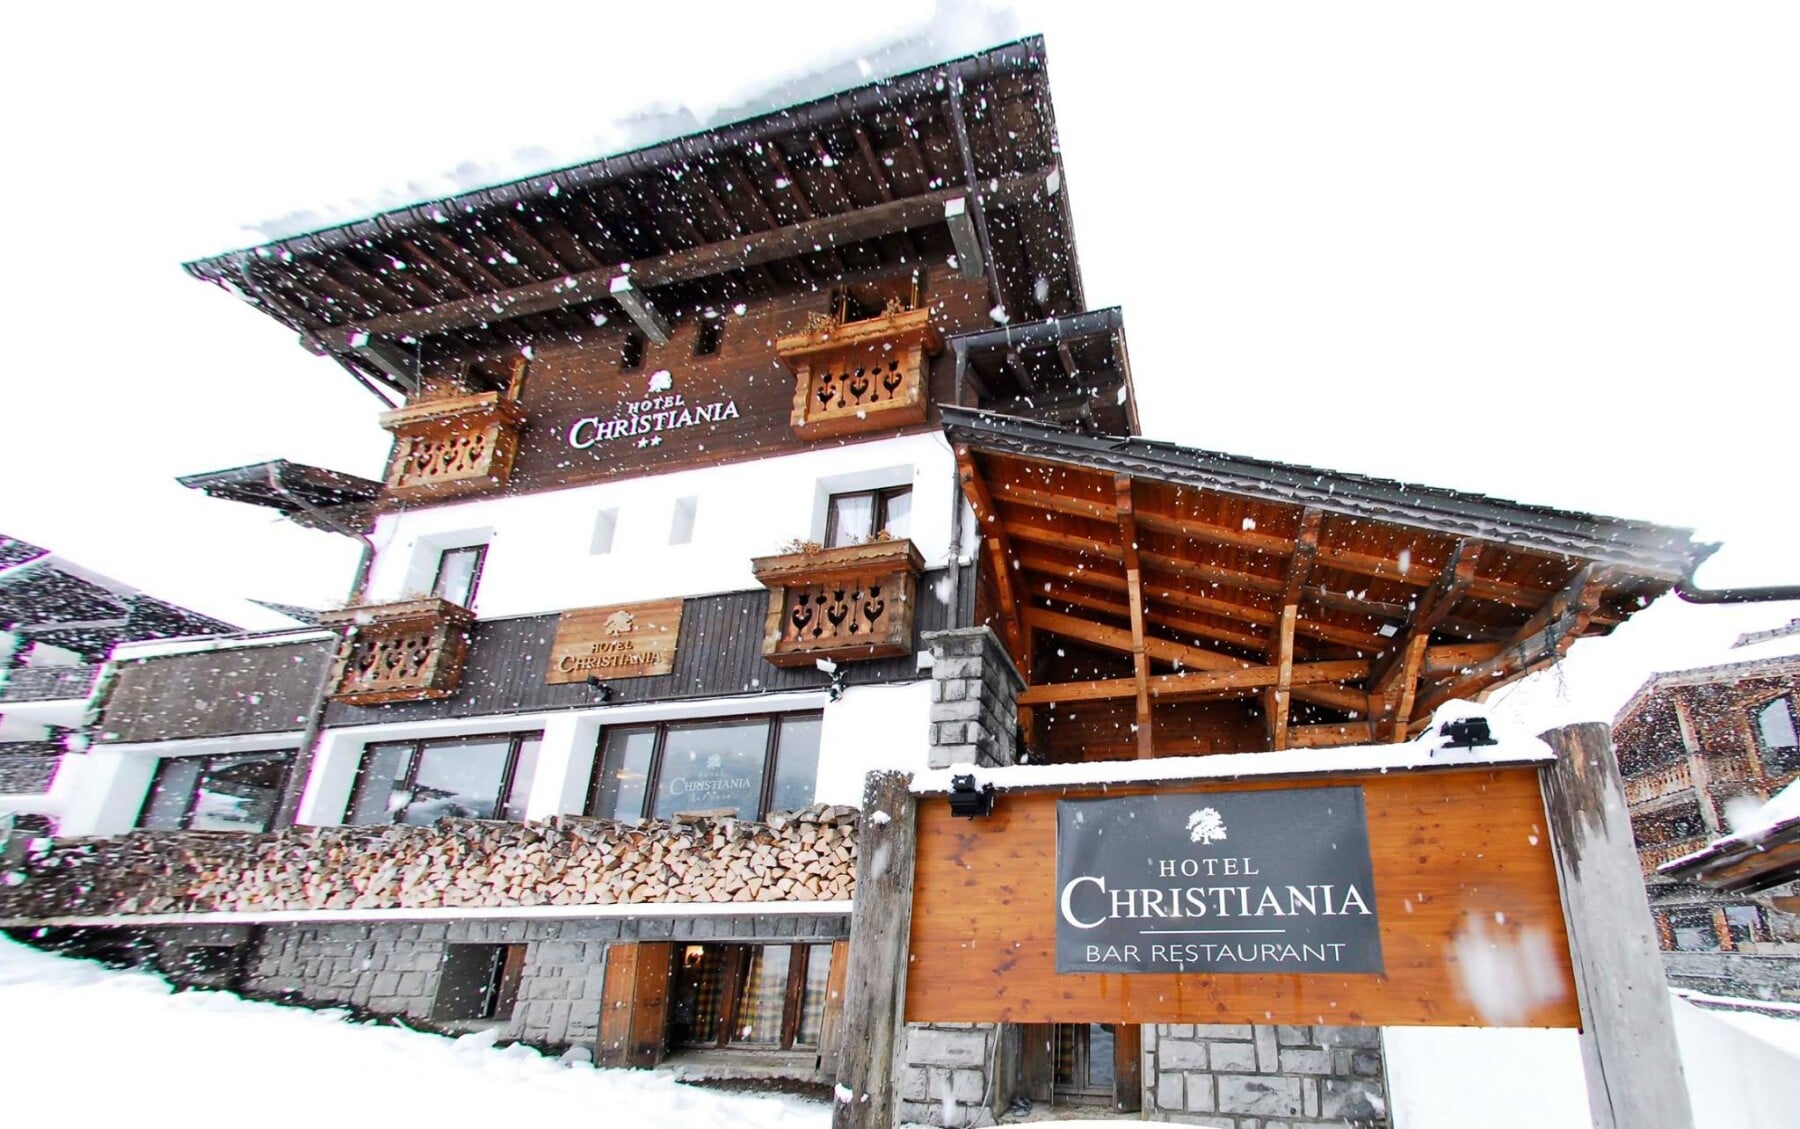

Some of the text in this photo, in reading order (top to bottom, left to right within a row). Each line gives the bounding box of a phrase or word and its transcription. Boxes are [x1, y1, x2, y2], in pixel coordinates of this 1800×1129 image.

[627, 394, 685, 415] HOTEL
[569, 401, 740, 449] CHRISTIANIA
[592, 640, 634, 654] HOTEL
[559, 652, 662, 673] CHRISTIANIA
[670, 777, 751, 796] CHRISTIANIA
[1158, 857, 1259, 878] HOTEL
[1060, 876, 1373, 930] CHRISTIANIA
[1086, 943, 1346, 963] BAR RESTAURANT
